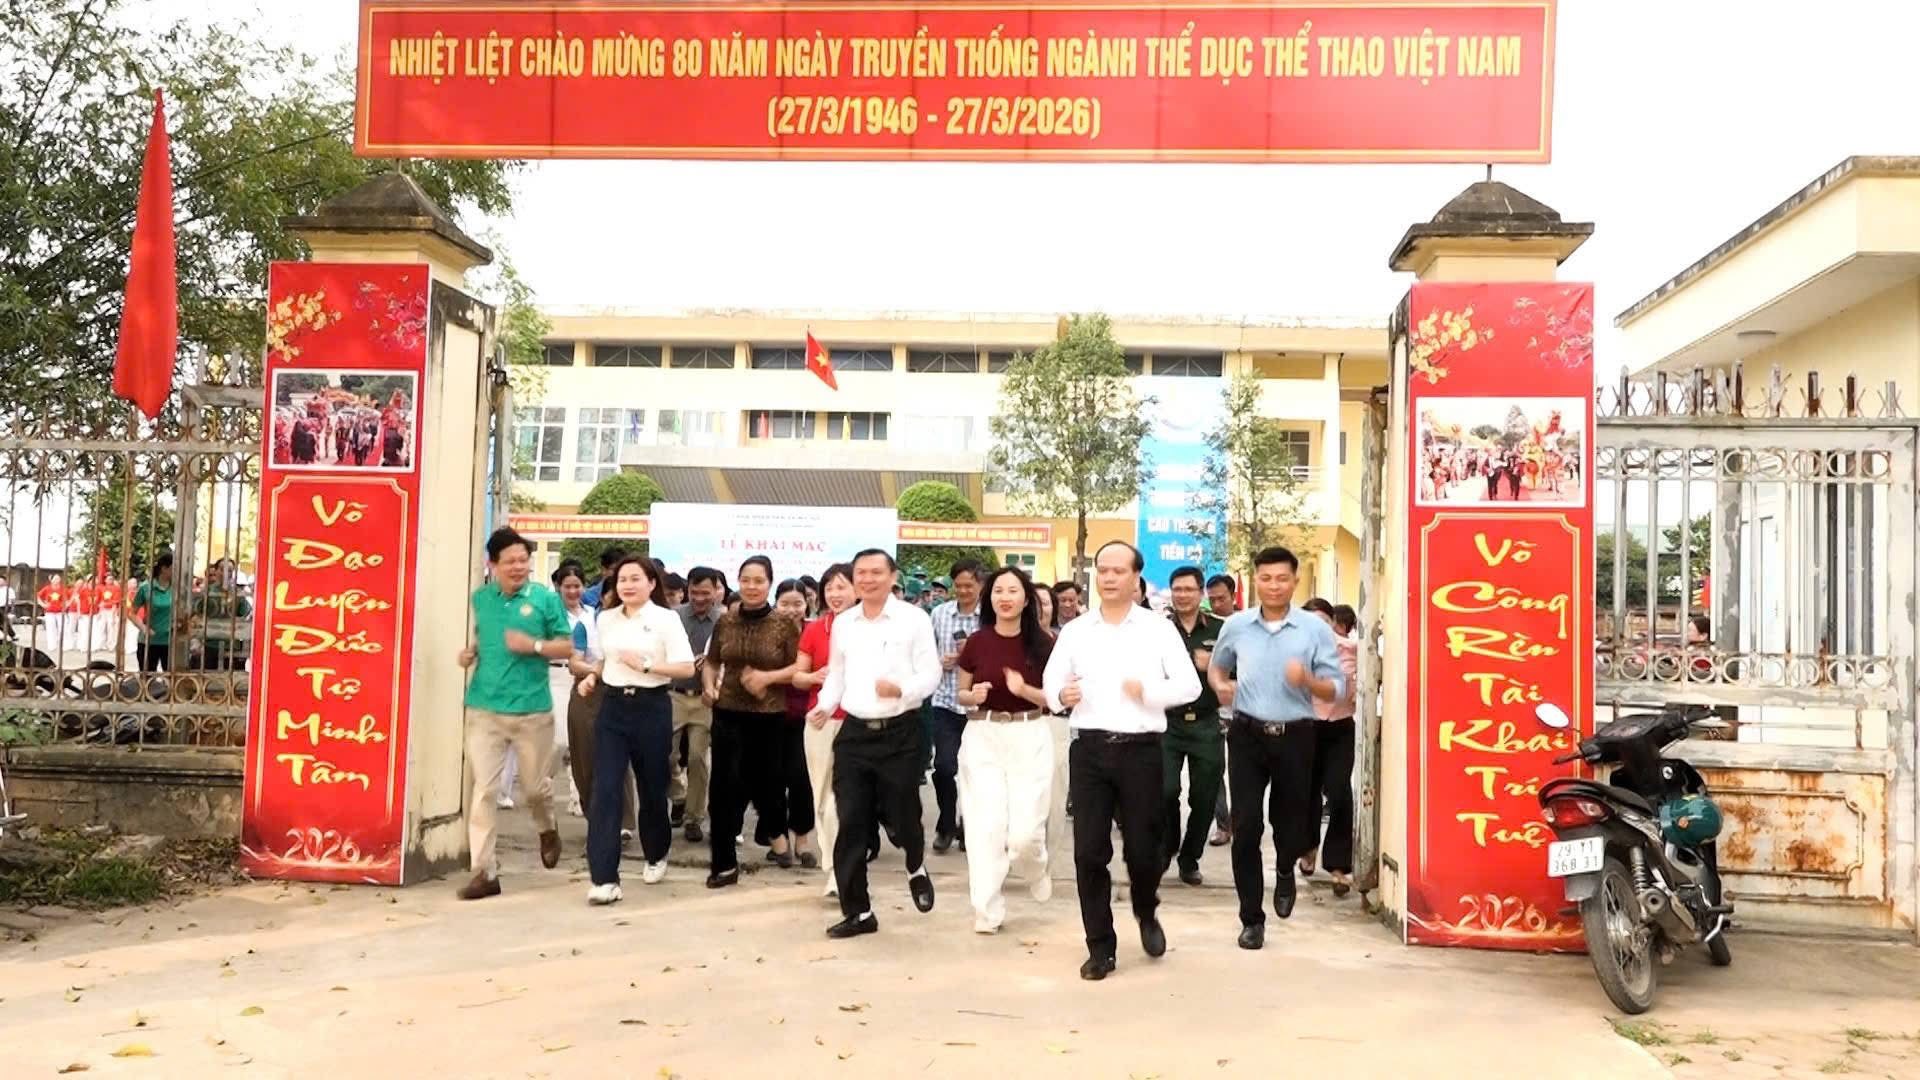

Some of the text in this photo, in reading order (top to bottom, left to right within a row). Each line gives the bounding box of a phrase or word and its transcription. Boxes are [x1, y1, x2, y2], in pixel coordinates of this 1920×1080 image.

[390, 20, 1523, 85] NHIỆT LIỆT CHÀO MỪNG 80 NĂM NGÀY TRUYỀN THỐNG NGÀNH THỂ DỤC THỂ THAO VIỆT NAM
[767, 96, 1101, 139] (27/3/1946 - 27/3/2026)
[311, 495, 368, 526] Võ
[282, 538, 384, 571] Đạo
[744, 538, 786, 551] KHAI
[1160, 541, 1185, 561] TIẾN
[1474, 533, 1537, 567] Võ
[274, 581, 391, 632] Luyện
[1431, 581, 1569, 640] Công
[275, 623, 384, 656] Đức
[1446, 626, 1559, 662] Rèn
[296, 666, 361, 701] Tự
[1462, 673, 1543, 707] Tài
[277, 709, 388, 746] Minh
[1438, 719, 1569, 754] Khai
[276, 753, 369, 791] Tâm
[1464, 766, 1540, 801] Trí
[284, 827, 361, 866] 2026
[1456, 812, 1549, 849] Tuệ
[1457, 893, 1547, 933] 2026
